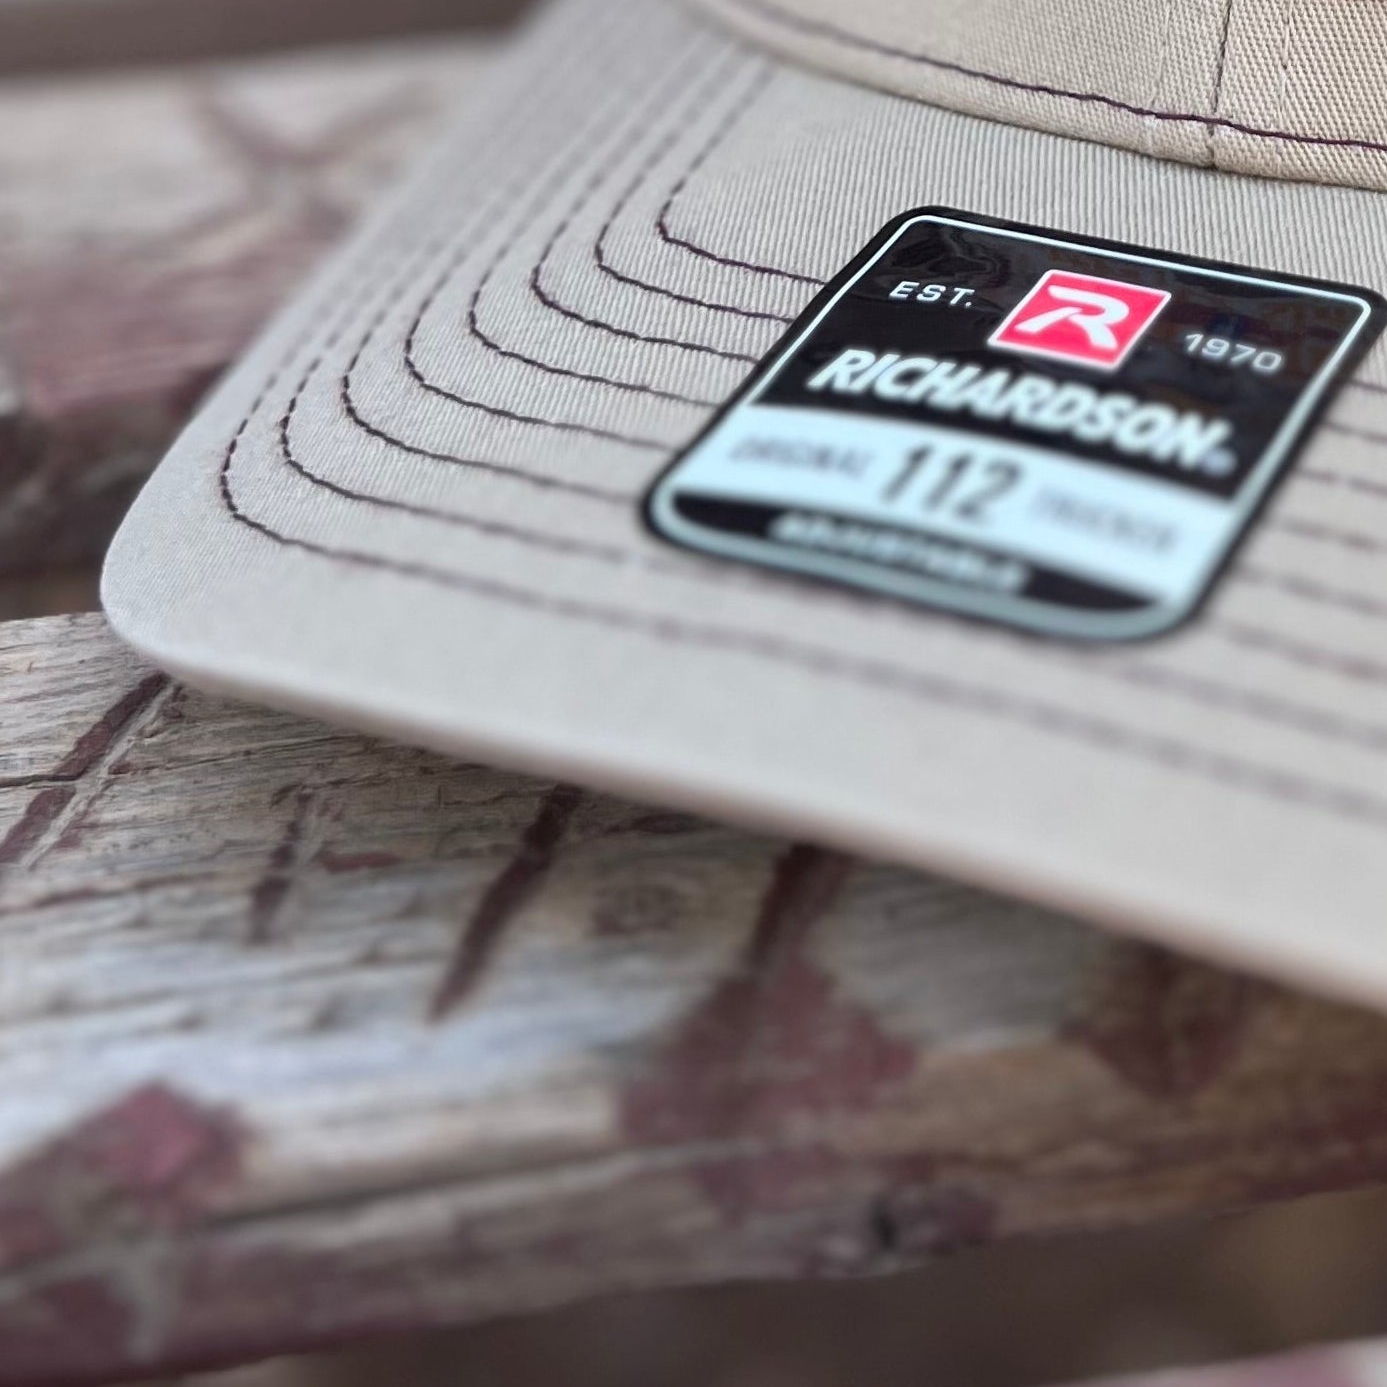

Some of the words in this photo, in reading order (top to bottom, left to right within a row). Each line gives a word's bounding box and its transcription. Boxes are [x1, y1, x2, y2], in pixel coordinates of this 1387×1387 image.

[887, 280, 976, 308] EST.
[1184, 332, 1284, 375] 1970
[806, 346, 1233, 469] RICHARDSON
[880, 442, 1026, 523] 112
